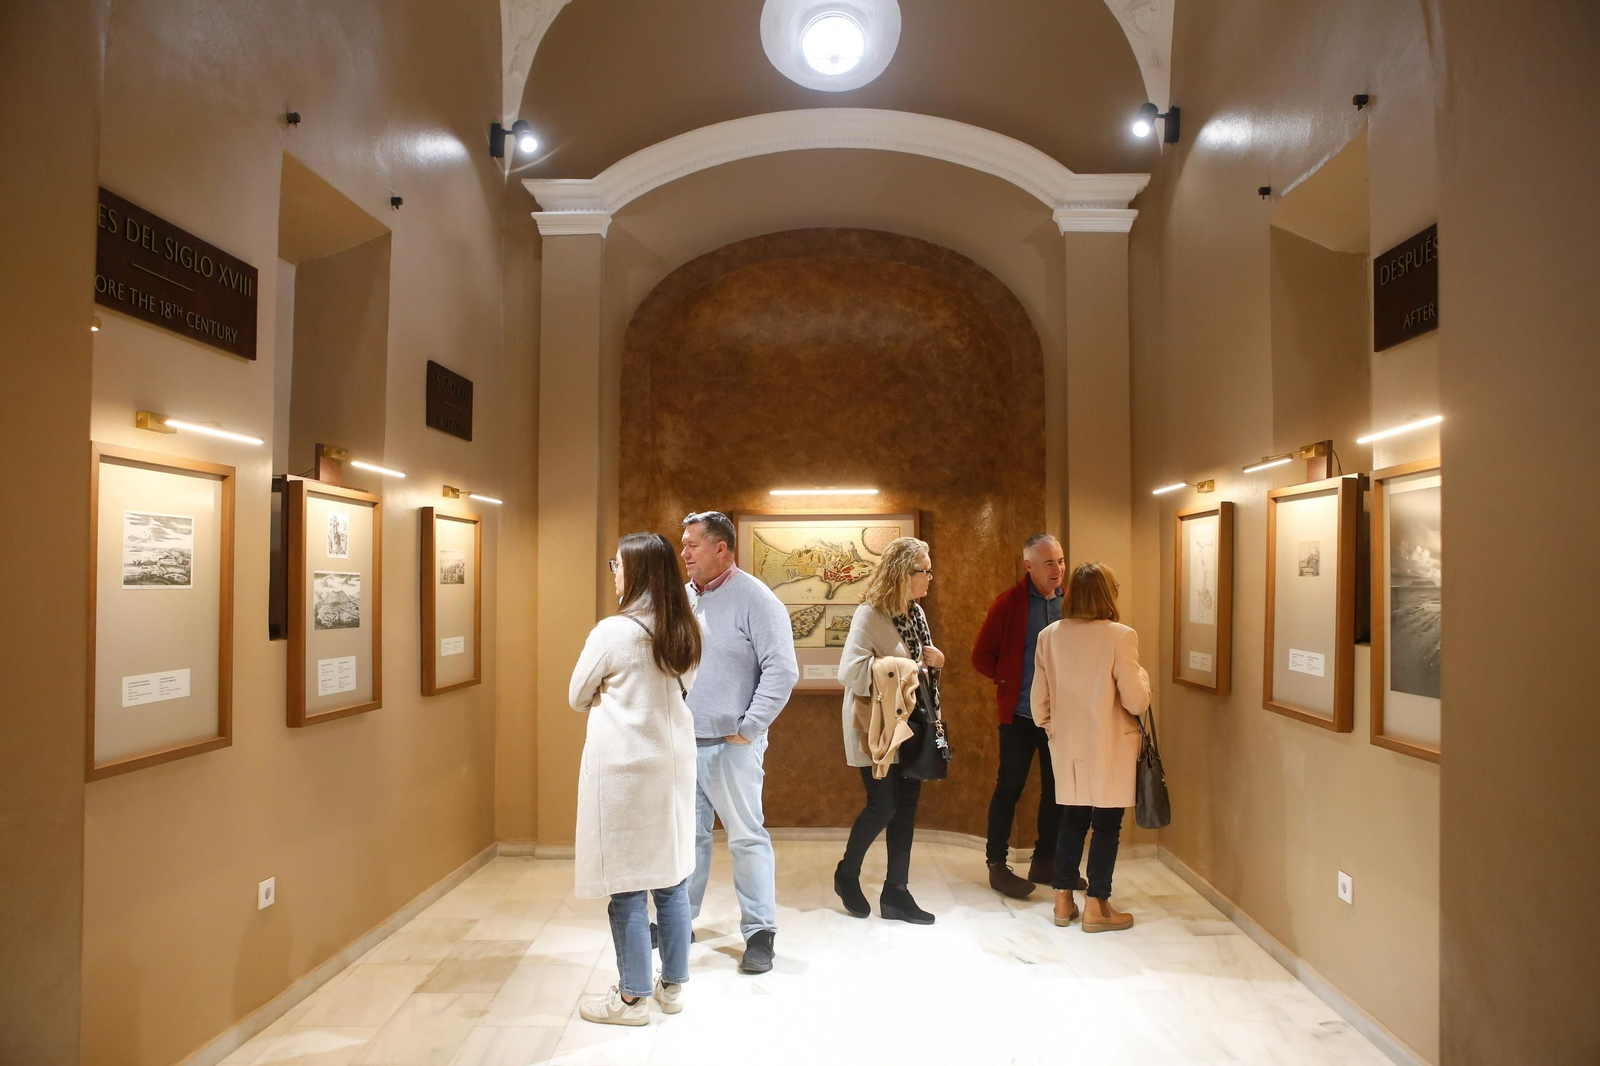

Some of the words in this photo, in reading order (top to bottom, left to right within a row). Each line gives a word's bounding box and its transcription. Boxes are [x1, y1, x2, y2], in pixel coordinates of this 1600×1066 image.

[97, 203, 117, 233] ES
[126, 217, 158, 254] DEL
[165, 237, 214, 278] SIGLO
[218, 263, 252, 297] XVIII
[95, 274, 124, 301] ORE
[129, 287, 155, 313] THE
[159, 300, 183, 319] 18TH
[186, 311, 238, 344] CENTURY
[1403, 303, 1436, 330] AFTER
